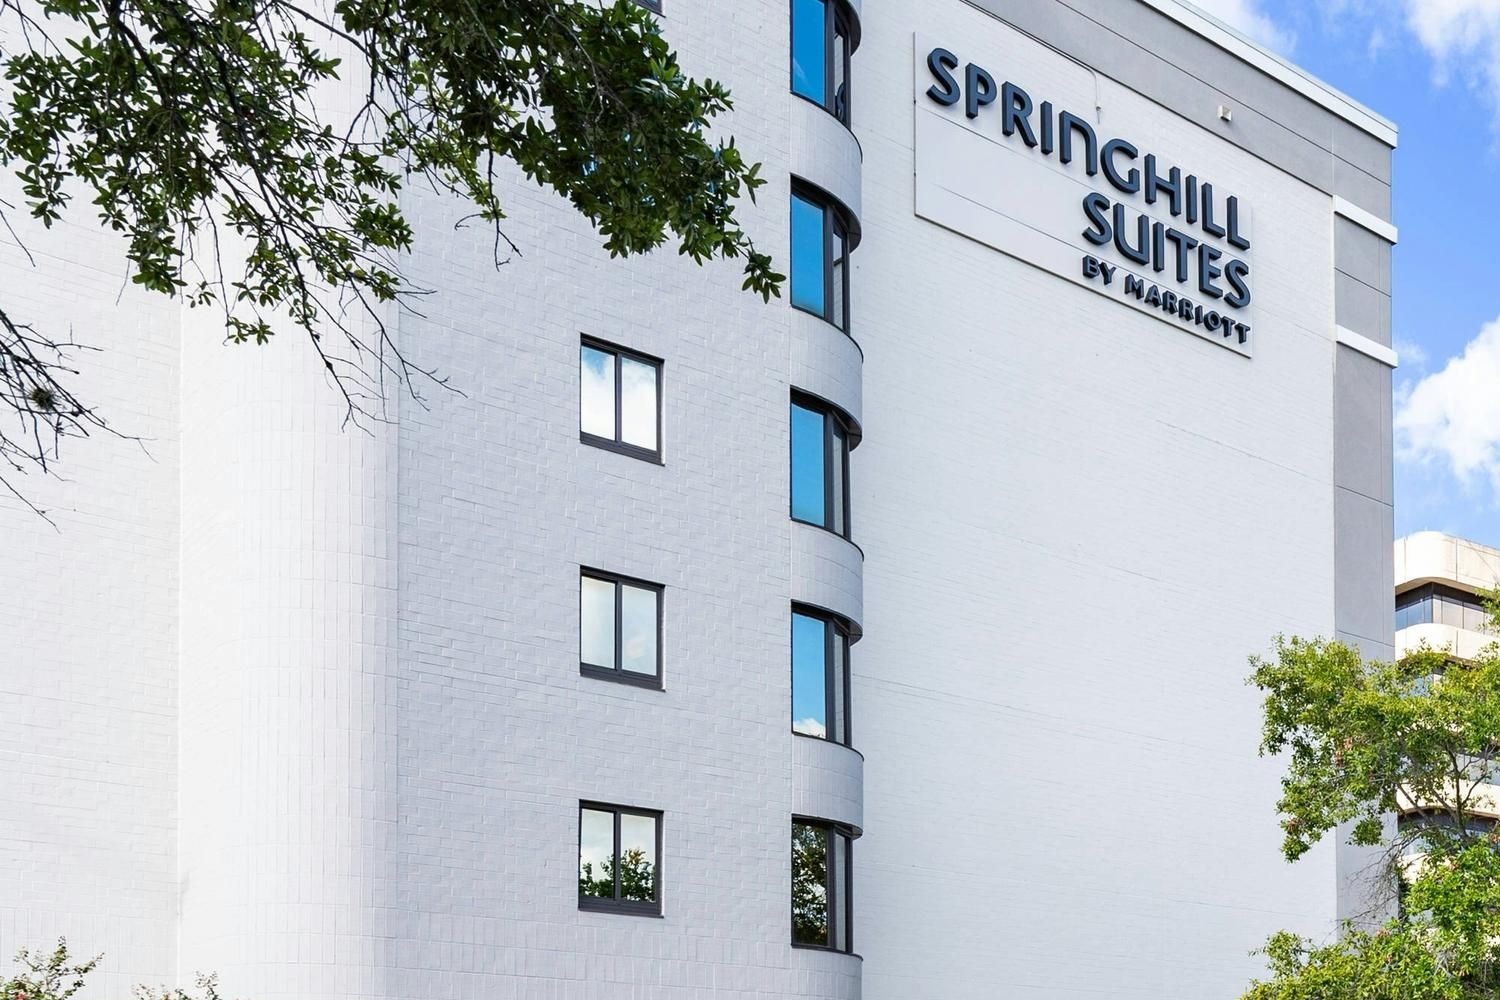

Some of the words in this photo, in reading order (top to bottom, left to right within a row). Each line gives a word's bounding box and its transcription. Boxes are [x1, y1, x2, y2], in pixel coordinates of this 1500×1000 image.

[926, 47, 1250, 251] SPRINGHILL
[1082, 192, 1251, 308] SUITES
[1082, 255, 1116, 285] BY
[1125, 273, 1251, 344] MARRIOTT
